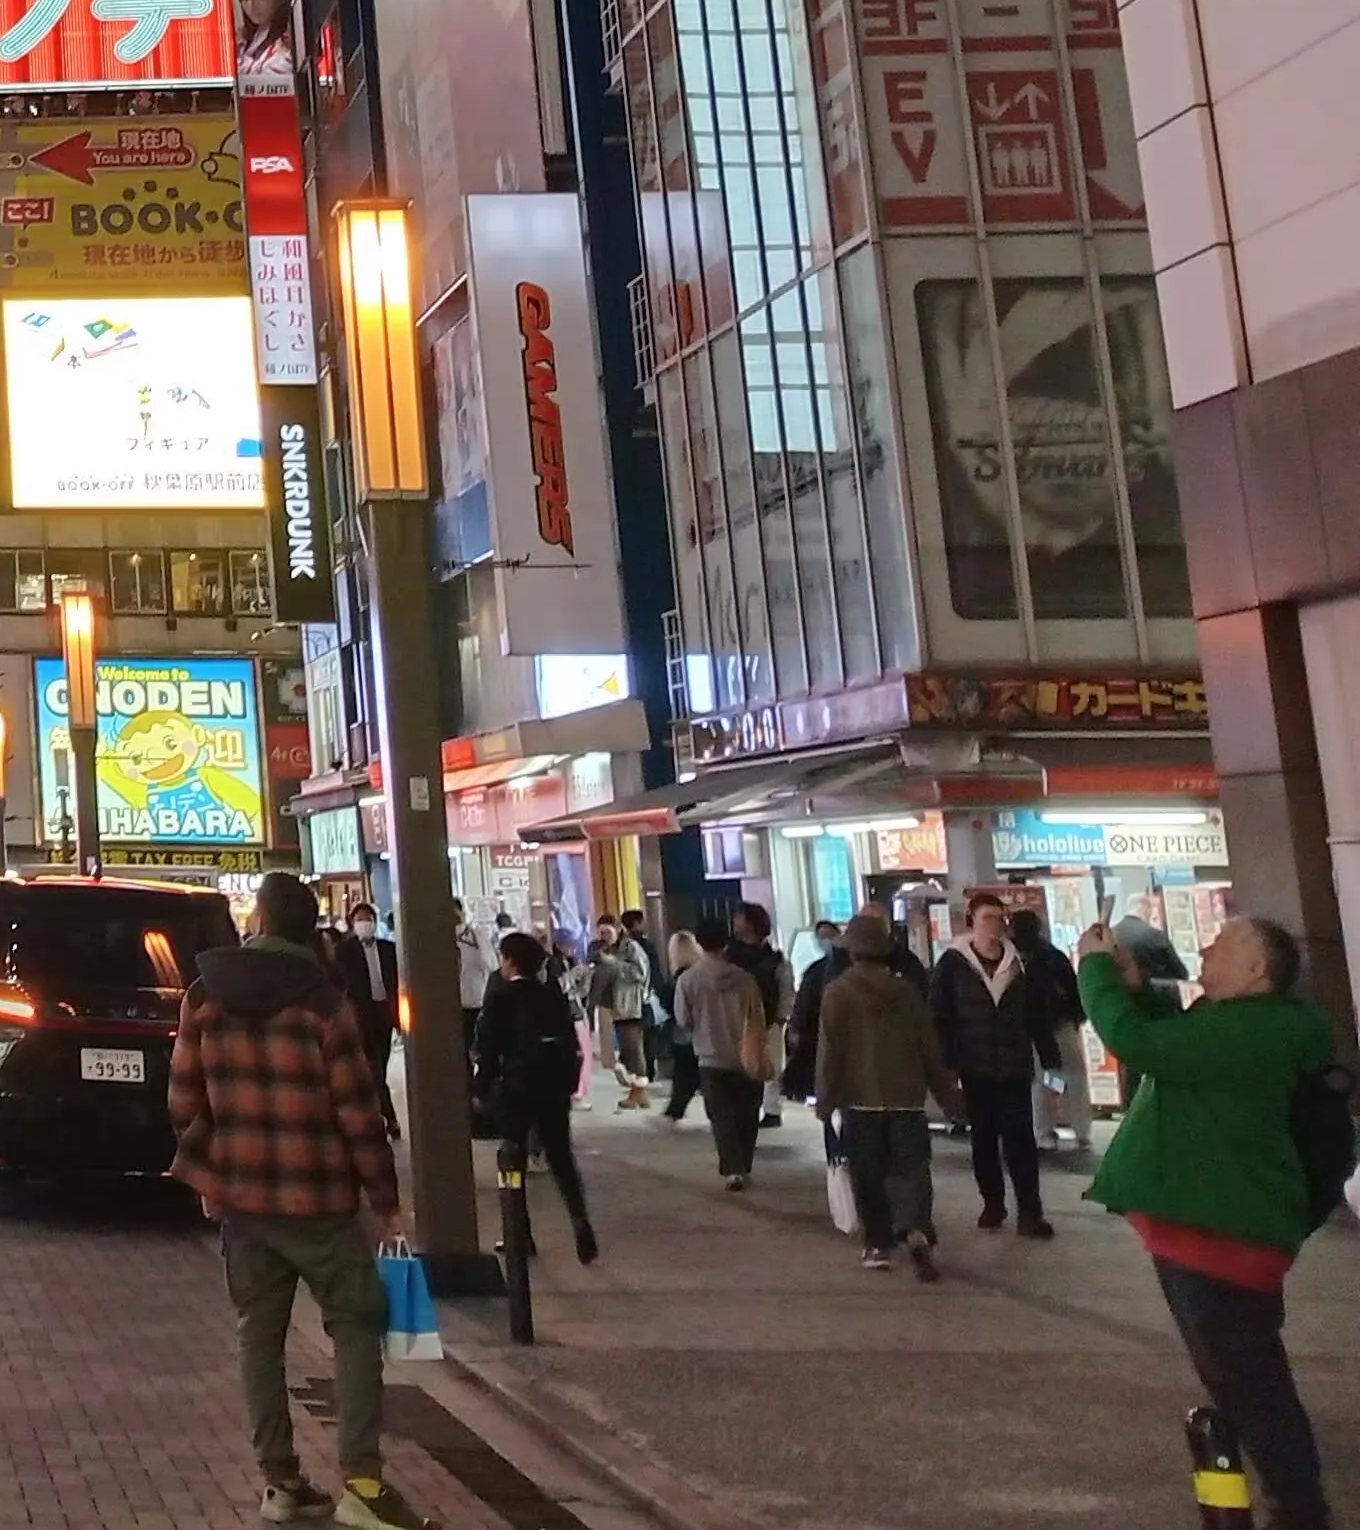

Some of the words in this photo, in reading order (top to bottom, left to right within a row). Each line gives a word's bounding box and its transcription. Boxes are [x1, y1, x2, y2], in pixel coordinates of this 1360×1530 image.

[118, 128, 182, 149] 現在地
[92, 151, 120, 165] You
[123, 153, 149, 164] are
[151, 150, 186, 164] here
[515, 281, 575, 558] GAMERS
[126, 437, 210, 451] フィギュア
[280, 423, 315, 580] SNKRDUNK
[98, 665, 170, 681] Welcome
[1022, 833, 1105, 856] hololive
[1164, 833, 1224, 854] PIECE
[130, 852, 167, 867] TAX
[94, 1061, 141, 1079] 99-99
